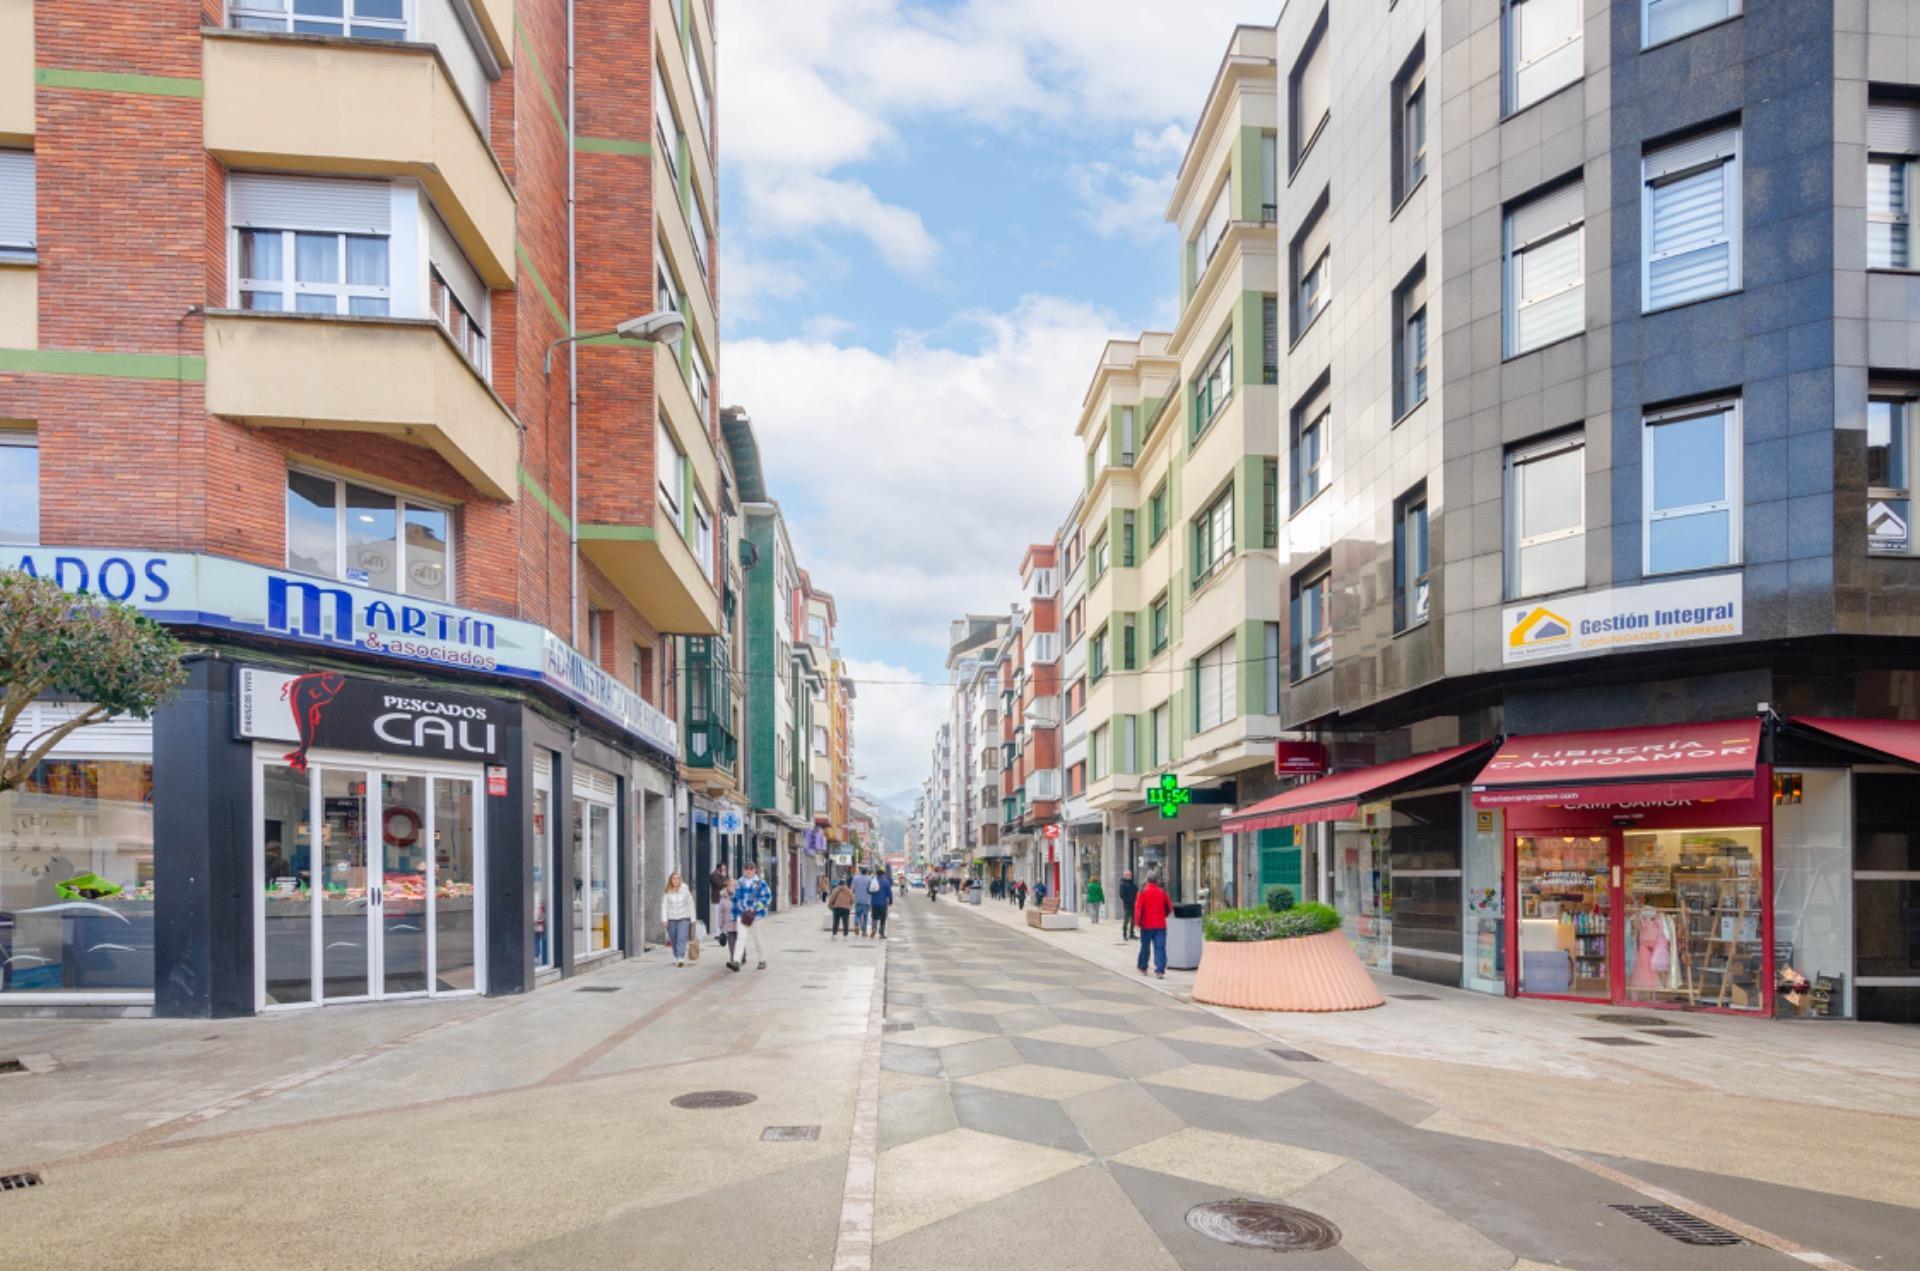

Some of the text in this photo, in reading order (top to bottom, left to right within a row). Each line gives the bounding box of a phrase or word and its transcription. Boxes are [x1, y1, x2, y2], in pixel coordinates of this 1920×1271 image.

[1580, 602, 1734, 635] Gestión Integral
[365, 632, 495, 670] & asociados
[383, 695, 487, 720] PESCADOS
[373, 712, 495, 754] CALI
[1489, 746, 1752, 769] CAMPOAMOR
[1532, 740, 1704, 760] LIBRERÍA
[1149, 789, 1188, 803] 11:54
